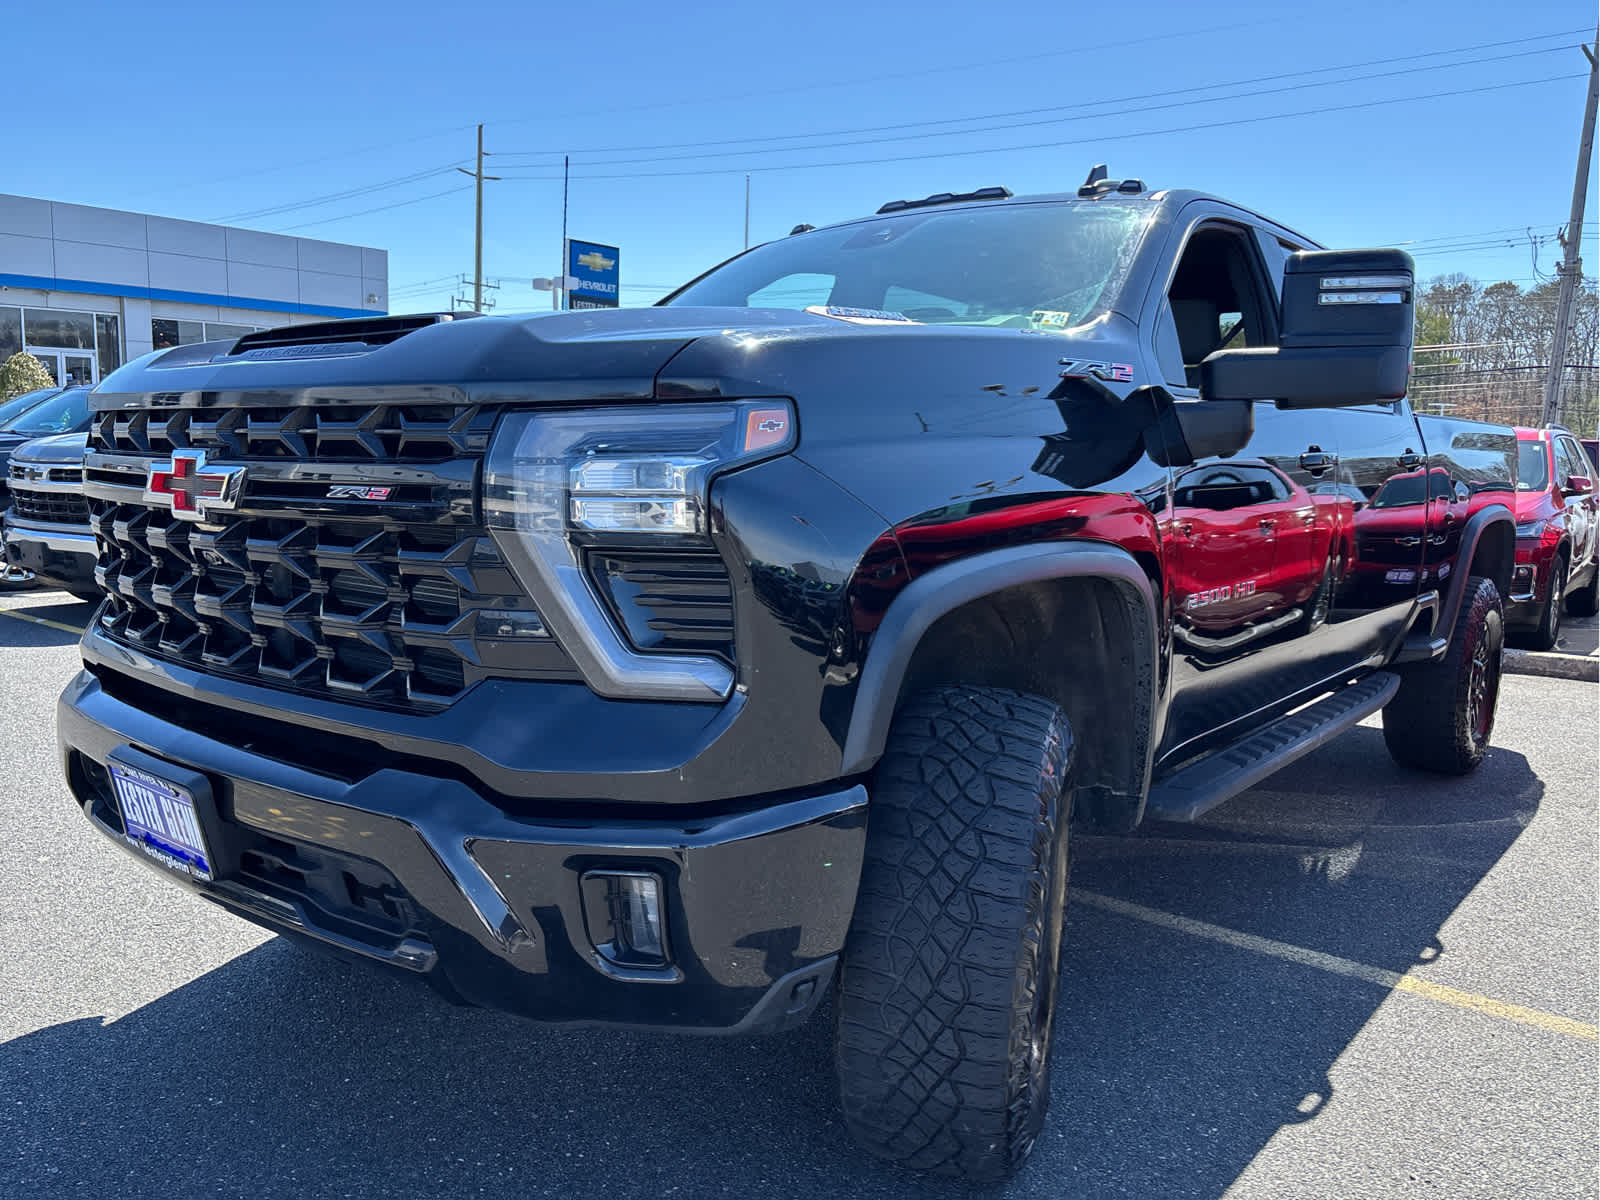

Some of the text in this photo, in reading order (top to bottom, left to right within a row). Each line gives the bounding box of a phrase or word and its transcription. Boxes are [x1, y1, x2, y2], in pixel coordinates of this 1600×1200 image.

[1058, 357, 1134, 383] ZR2
[326, 485, 391, 500] ZR2
[1186, 580, 1257, 610] 2500 HD
[115, 777, 166, 834] LESTER
